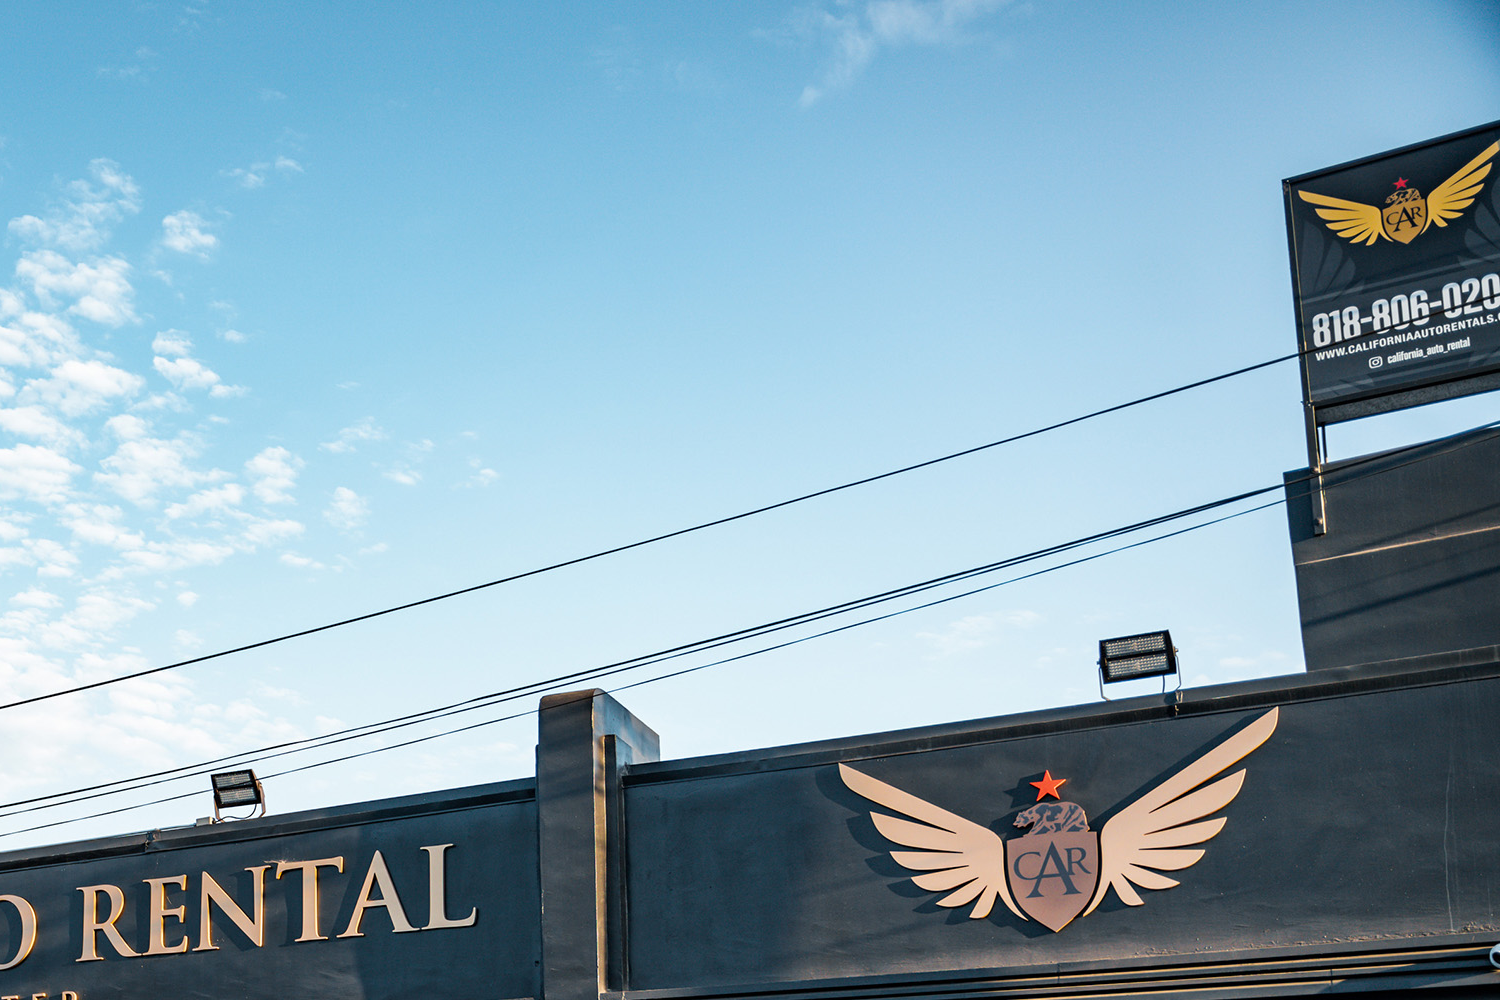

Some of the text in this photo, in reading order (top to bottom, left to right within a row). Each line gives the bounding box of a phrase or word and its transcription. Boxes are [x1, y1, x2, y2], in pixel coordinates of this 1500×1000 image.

[1385, 206, 1423, 233] CAR
[1312, 273, 1500, 348] 818-806-020
[1315, 313, 1500, 361] WWW.CALIFORNIAAUTORENTALS.
[1387, 336, 1471, 364] california_auto_rental
[1013, 841, 1092, 899] CAR
[75, 843, 477, 963] RENTAL
